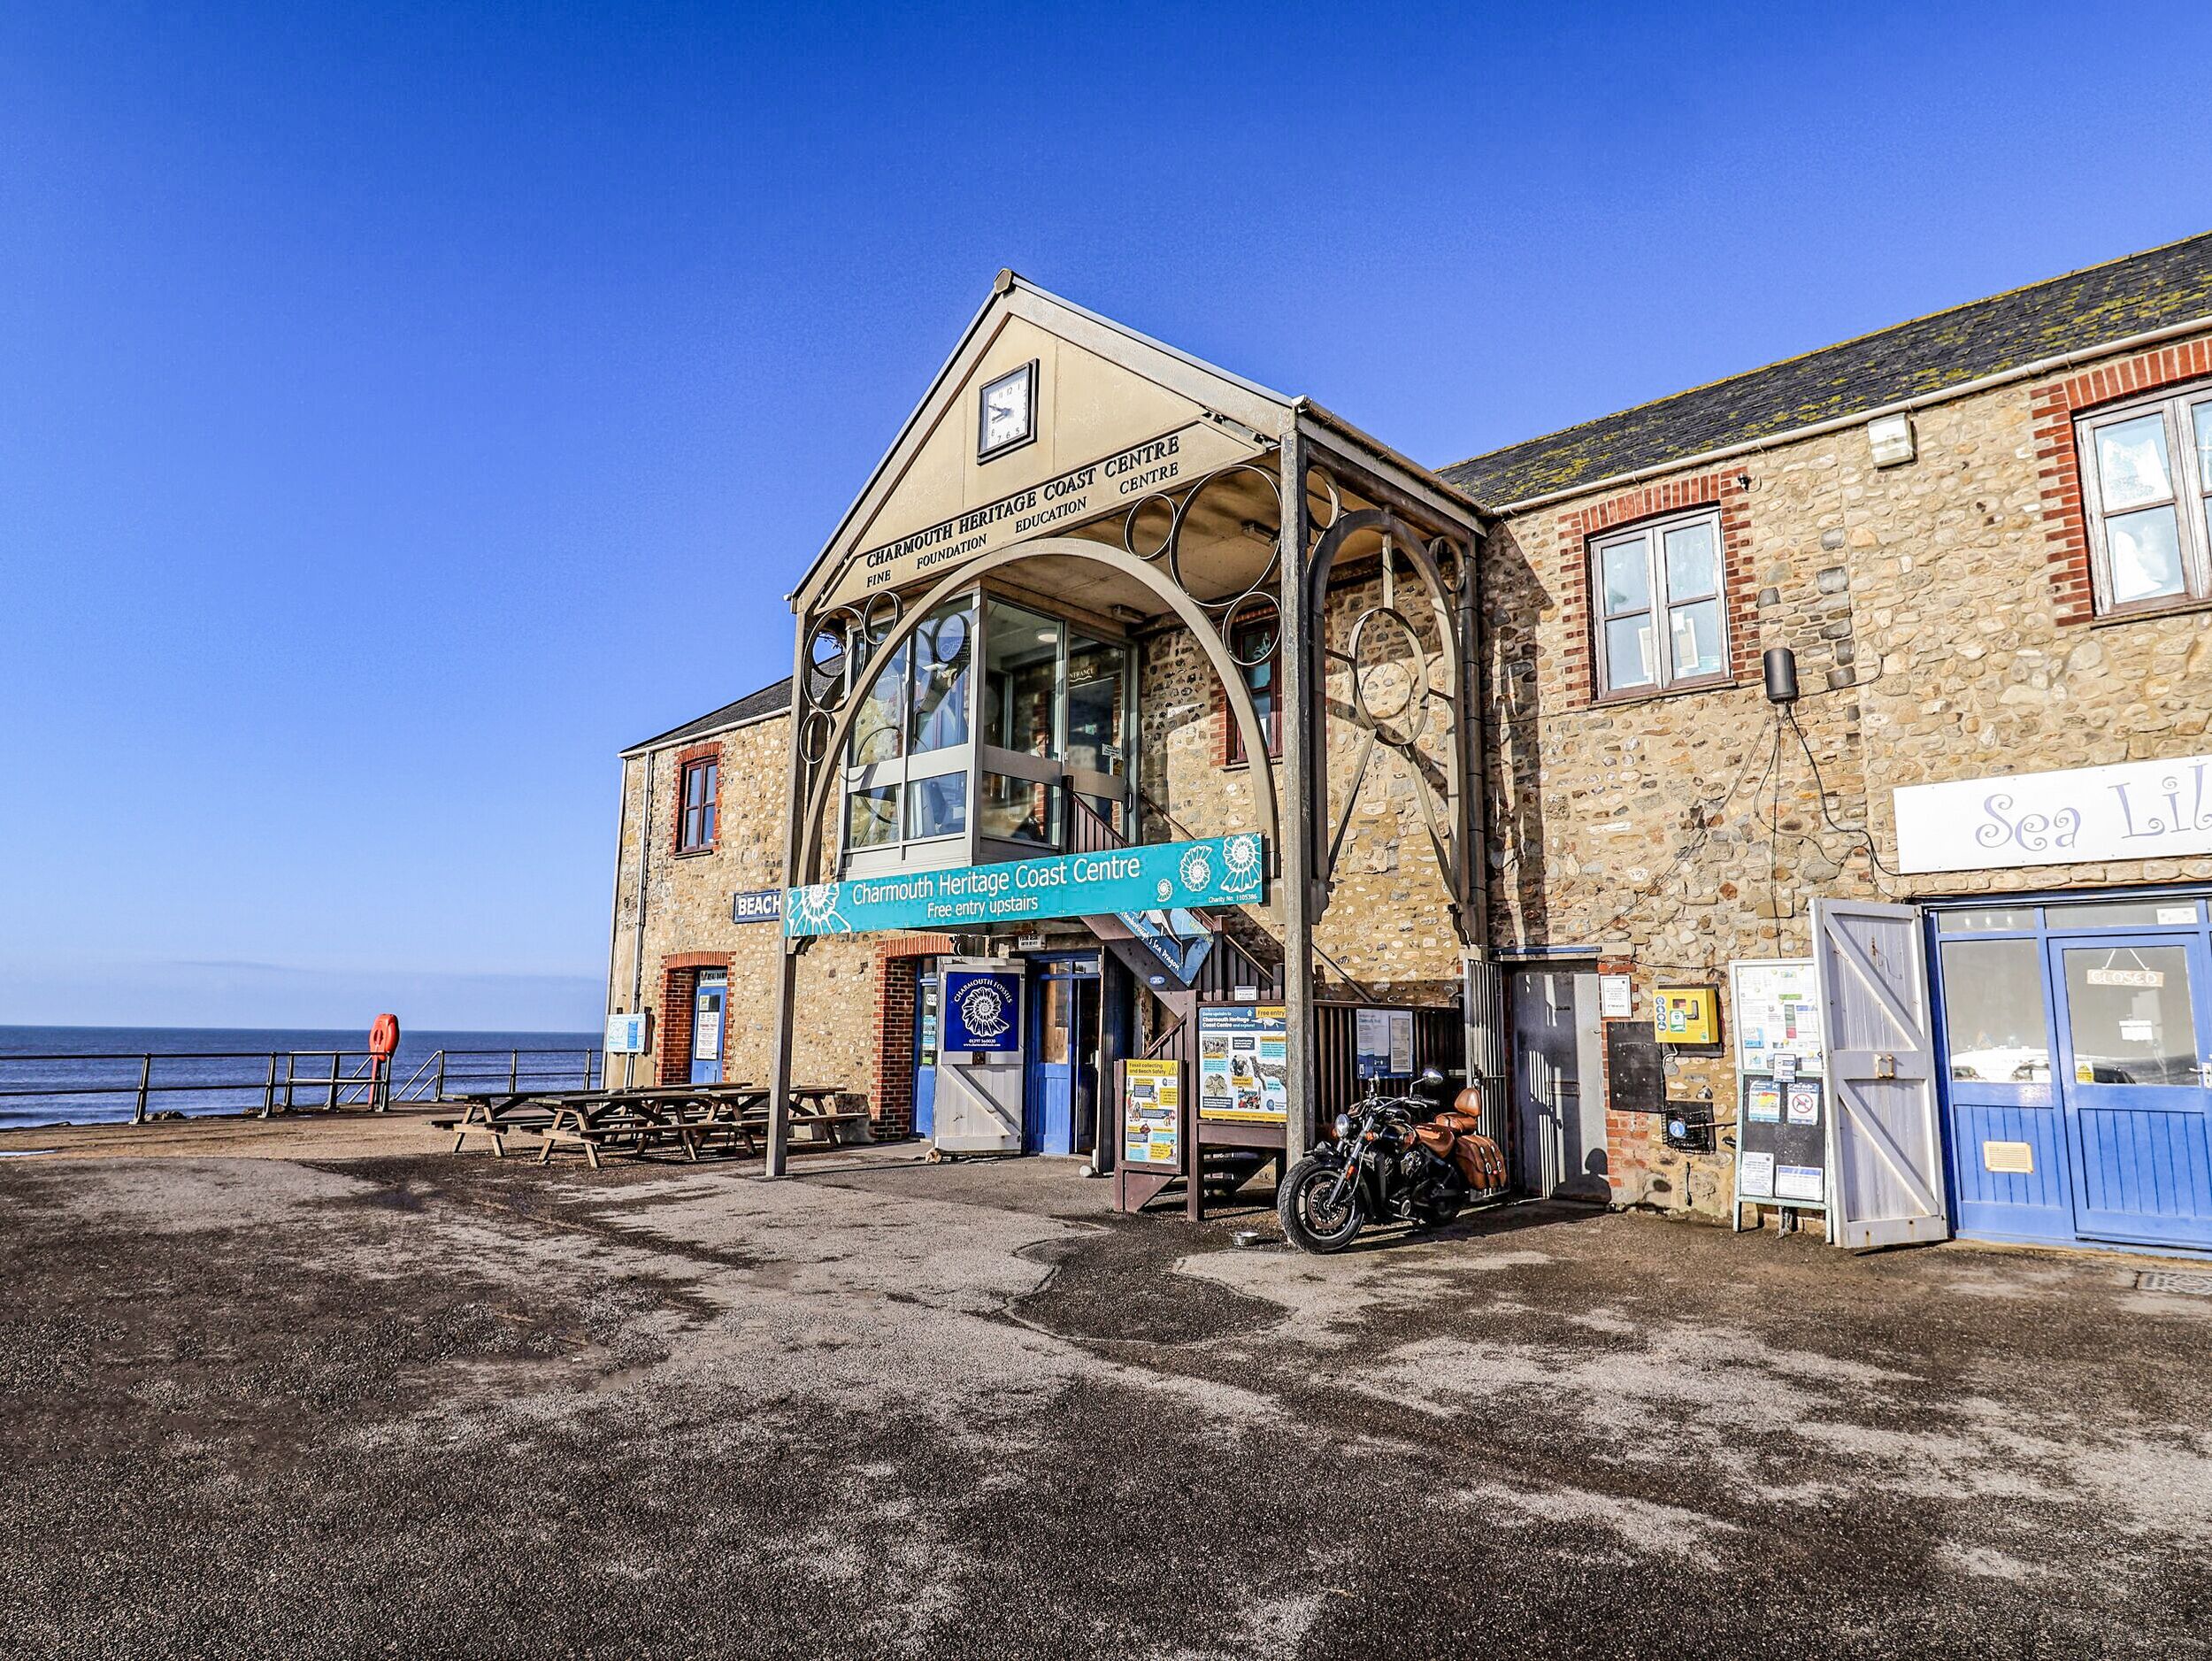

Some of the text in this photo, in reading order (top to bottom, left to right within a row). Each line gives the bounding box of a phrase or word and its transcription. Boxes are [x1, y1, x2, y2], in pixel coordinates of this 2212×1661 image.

[866, 435, 1179, 568] CHARMOUTH HERITAGE COAST CENTRE
[866, 462, 1179, 588] FINE FOUNDATION EDUCATION CENTRE
[1070, 666, 1094, 679] NTRANCE
[1975, 793, 2081, 851] Sea
[852, 856, 1141, 904] Charmouth Heritage Coast Centre
[738, 894, 781, 915] BEACH
[927, 896, 1038, 919] Free entry upstairs
[1120, 911, 1180, 971] ttenborough's Sea Dragon
[954, 979, 1013, 1004] CHARMOUTH FOSSILS
[2091, 971, 2158, 985] CLOSED
